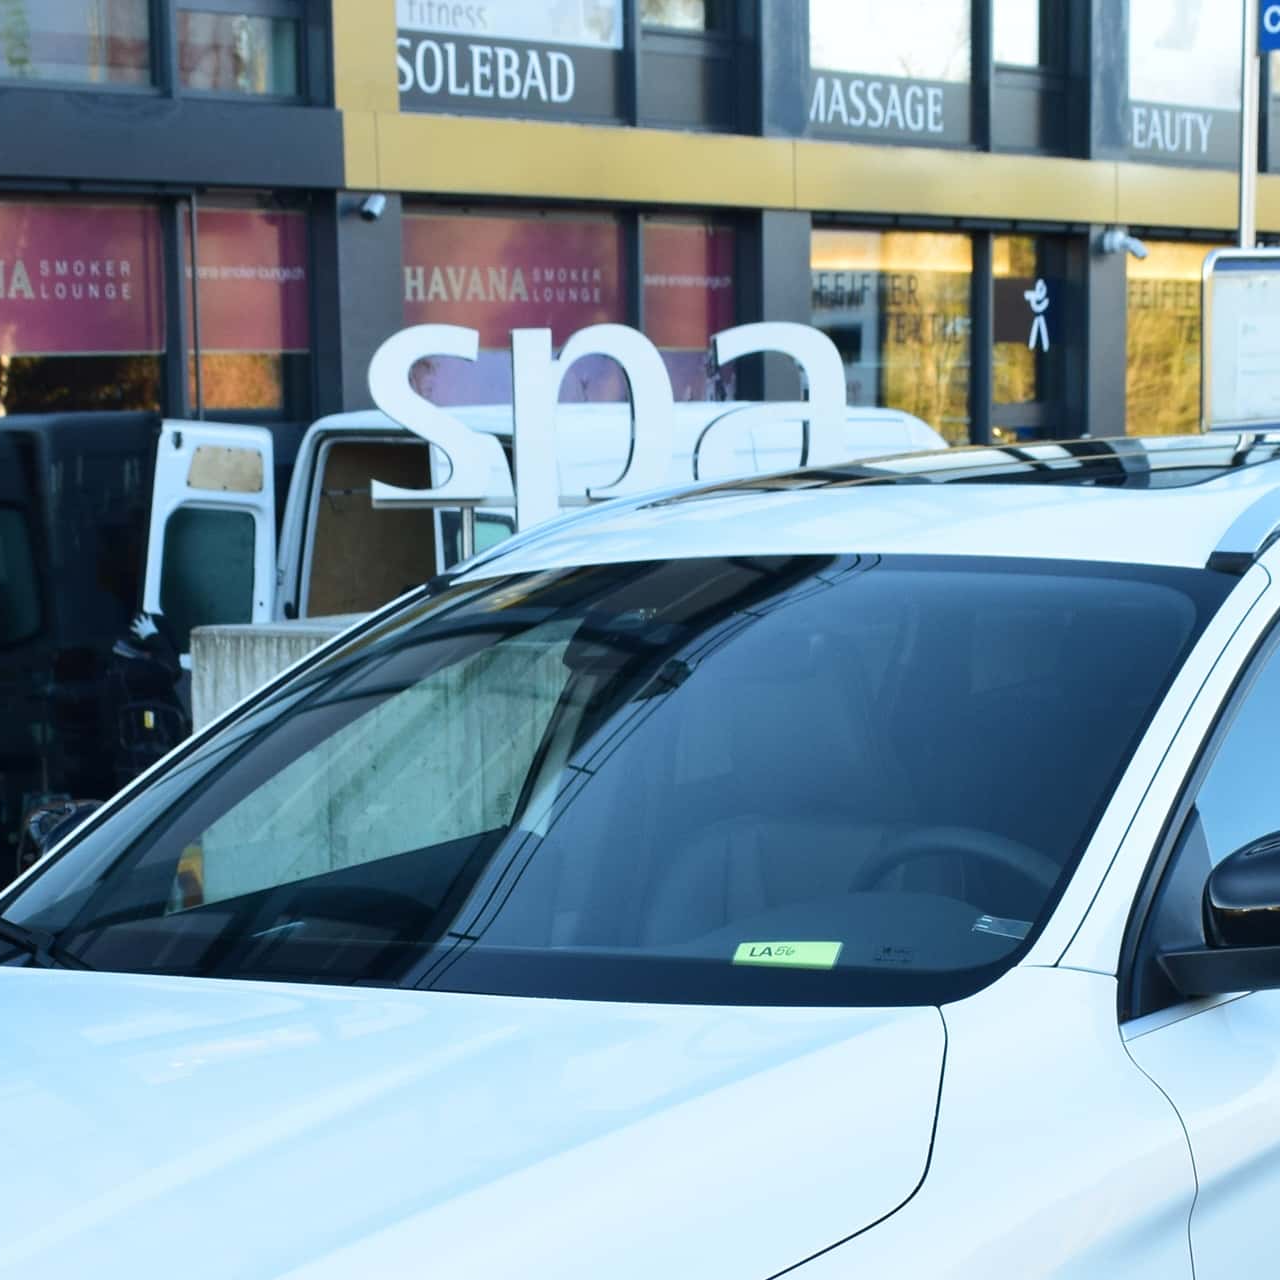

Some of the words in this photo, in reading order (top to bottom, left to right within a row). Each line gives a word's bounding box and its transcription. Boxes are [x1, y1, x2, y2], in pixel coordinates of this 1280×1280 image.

[396, 37, 576, 103] SOLEBAD
[1127, 106, 1213, 153] EAUTY
[39, 259, 131, 277] SMOKER
[532, 268, 601, 283] SMOKER
[40, 283, 131, 299] LOUNGE
[404, 265, 529, 302] HAVANA
[533, 287, 601, 303] LOUNGE
[368, 322, 847, 533] spa
